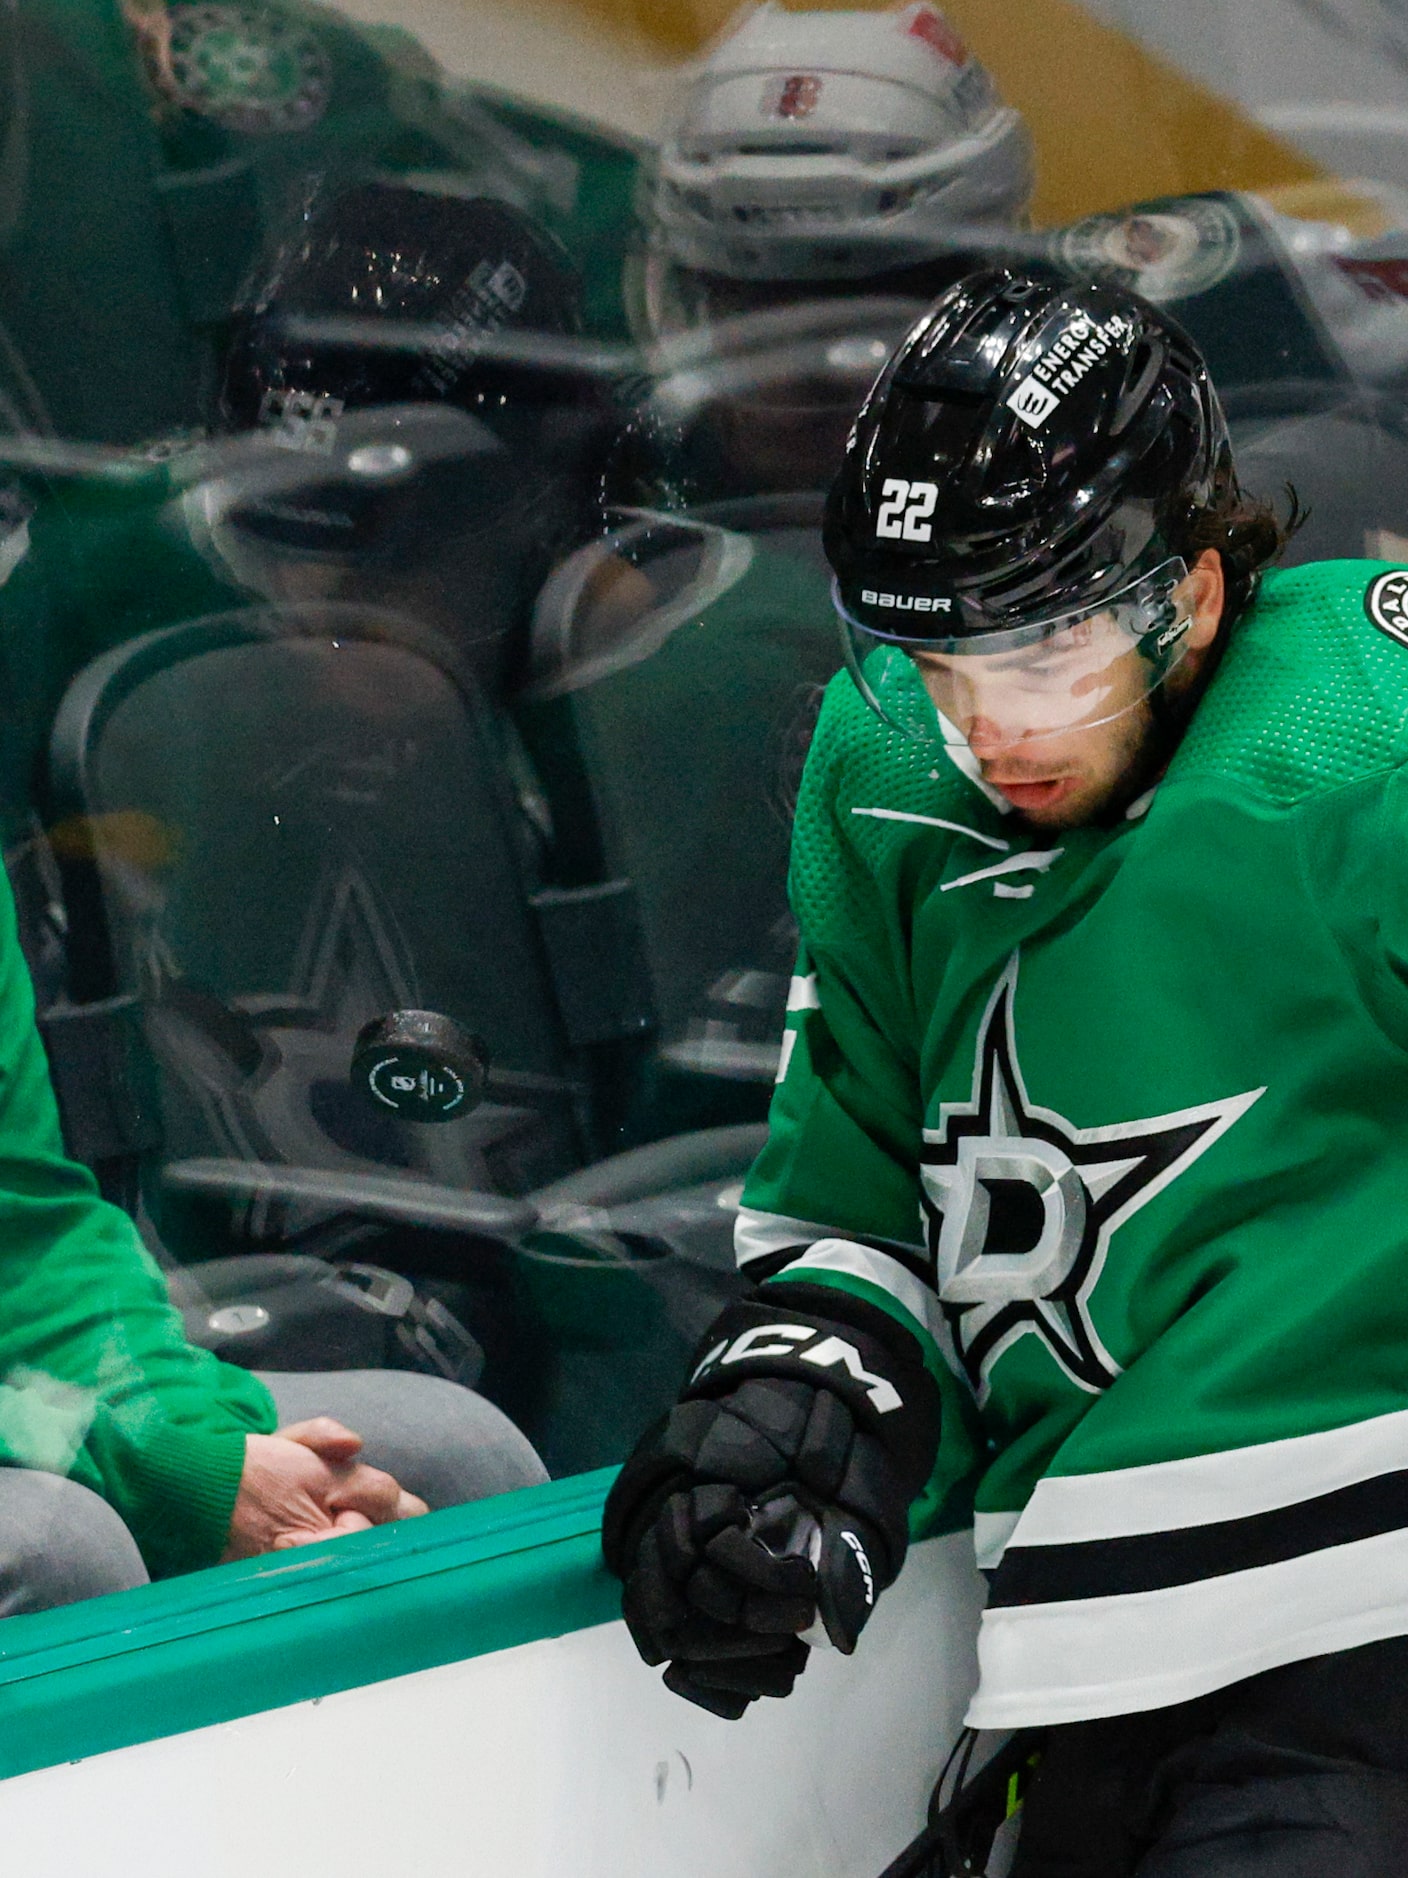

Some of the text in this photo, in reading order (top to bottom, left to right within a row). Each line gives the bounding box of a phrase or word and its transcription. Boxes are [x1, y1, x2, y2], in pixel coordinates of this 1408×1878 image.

[1033, 311, 1097, 382] ENERGY
[1051, 314, 1129, 395] TRANSFER
[876, 478, 939, 542] 22
[861, 589, 952, 613] BAUER
[840, 1530, 874, 1606] CCM
